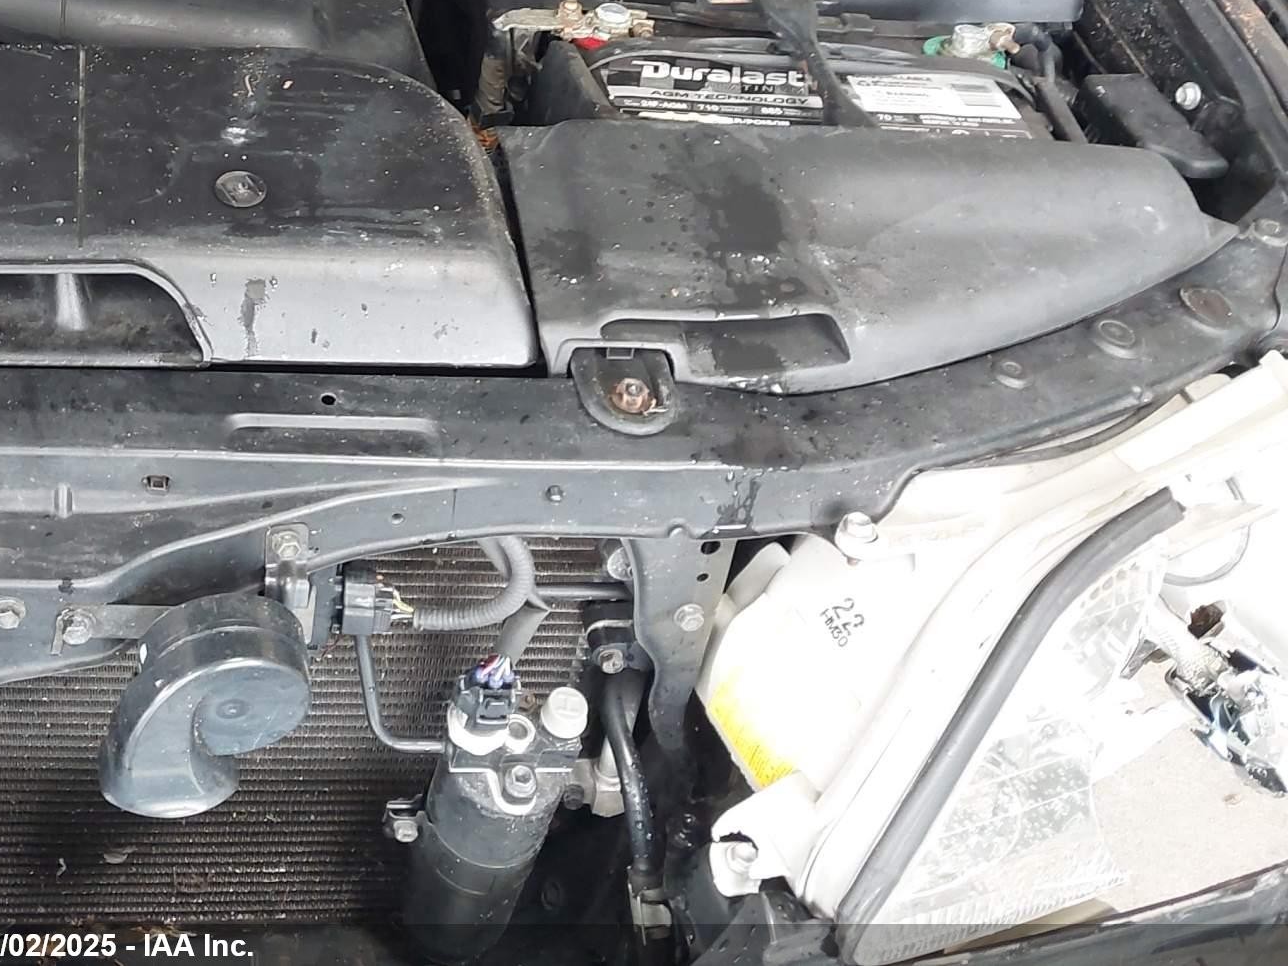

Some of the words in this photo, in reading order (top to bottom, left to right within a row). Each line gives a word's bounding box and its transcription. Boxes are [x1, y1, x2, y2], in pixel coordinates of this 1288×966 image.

[631, 60, 804, 87] Duralast
[650, 89, 690, 99] AGM
[693, 92, 810, 105] TECHNOLOGY
[832, 597, 864, 637] 22
